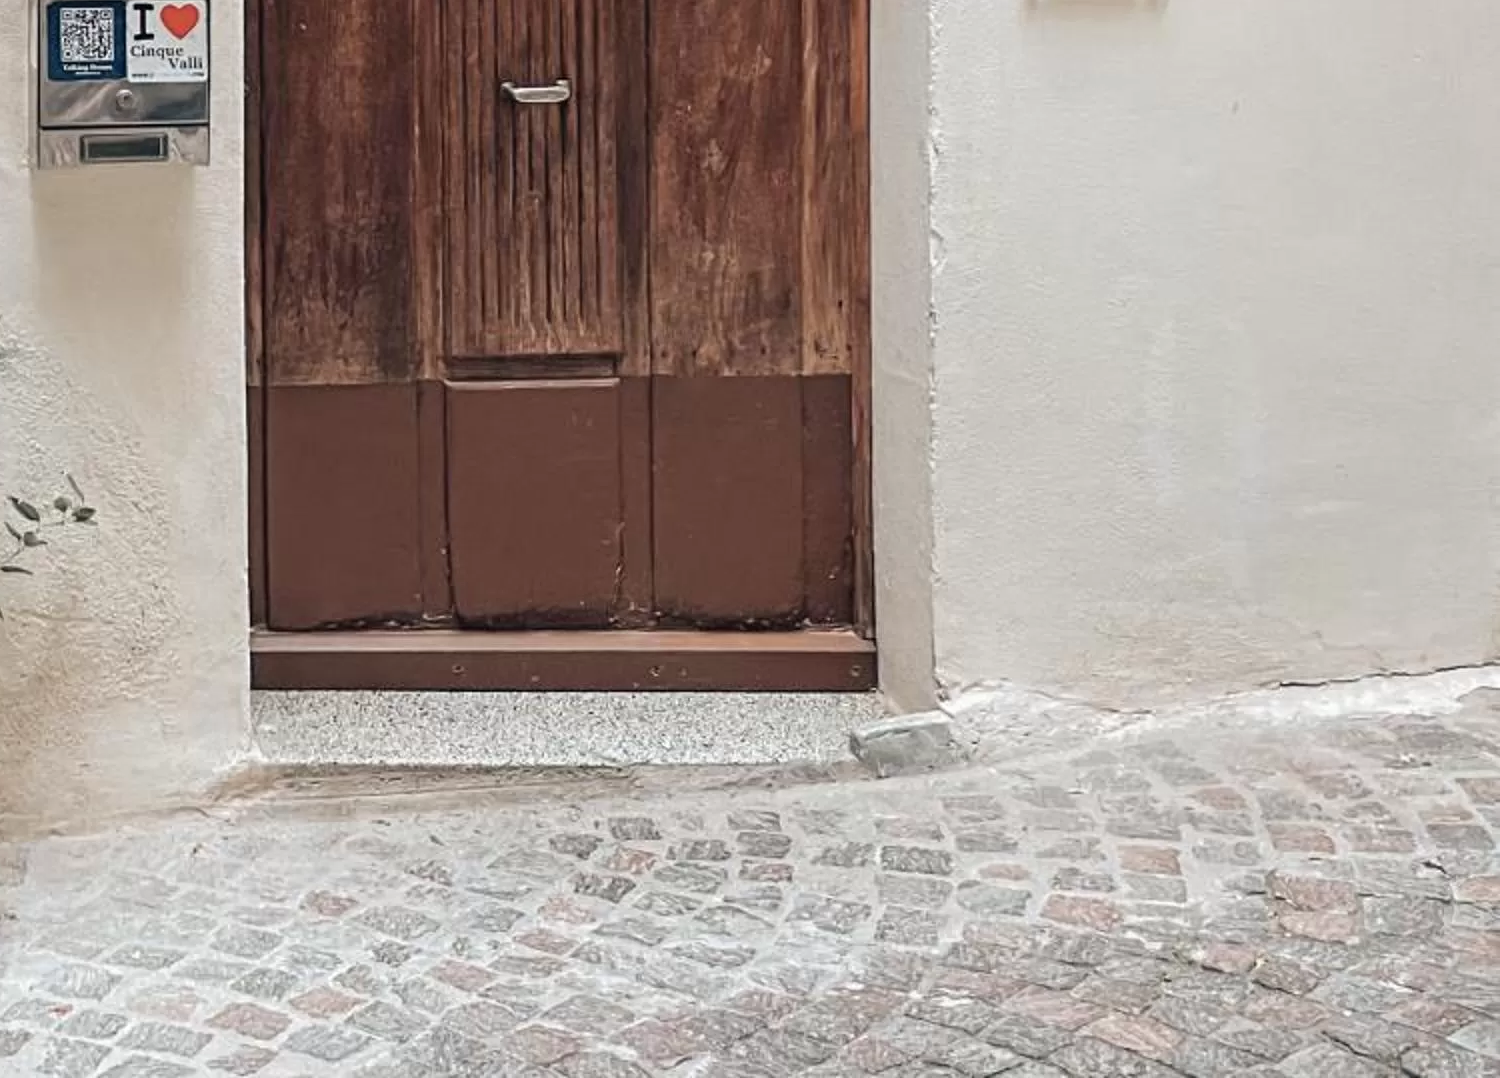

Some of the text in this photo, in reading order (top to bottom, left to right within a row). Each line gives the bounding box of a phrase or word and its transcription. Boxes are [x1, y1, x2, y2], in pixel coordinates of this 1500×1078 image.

[132, 3, 155, 41] I
[130, 44, 185, 59] Cinque
[167, 56, 204, 70] Valli
